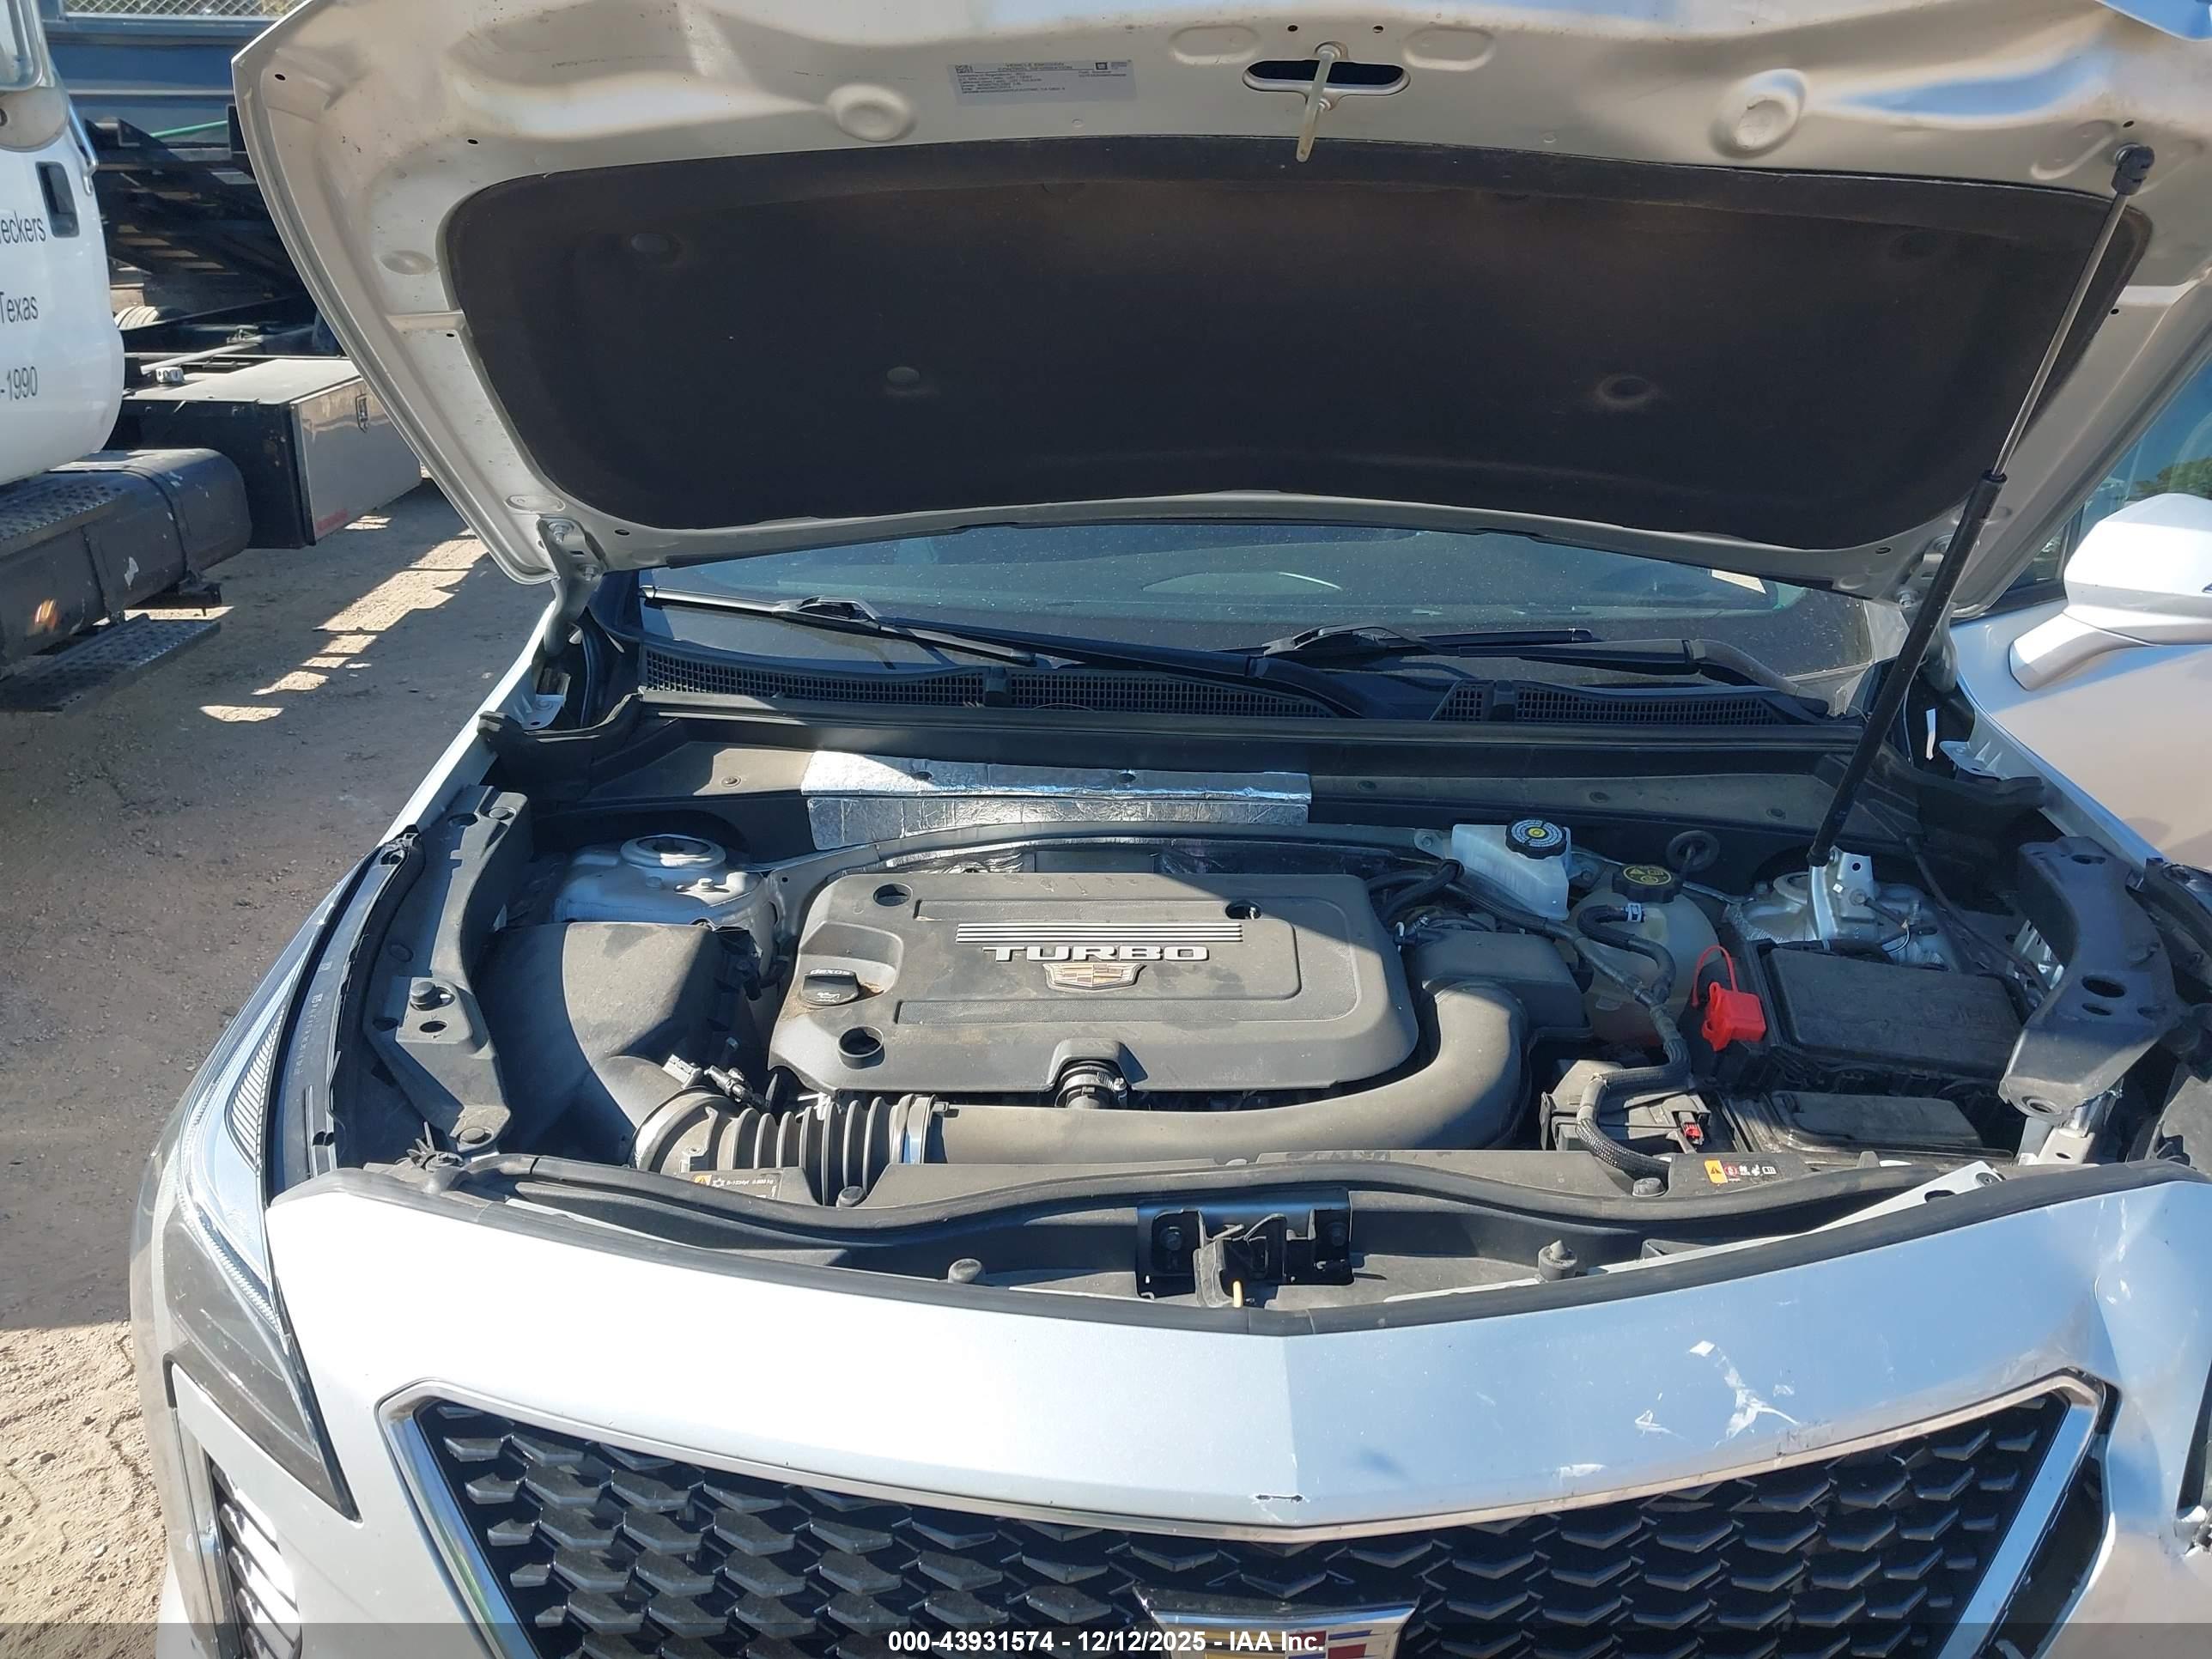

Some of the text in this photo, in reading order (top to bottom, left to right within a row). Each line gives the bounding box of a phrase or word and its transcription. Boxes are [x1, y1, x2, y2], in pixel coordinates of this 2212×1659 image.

[0, 210, 46, 244] eckers
[0, 290, 39, 324] Texas
[981, 945, 1210, 963] TURBO
